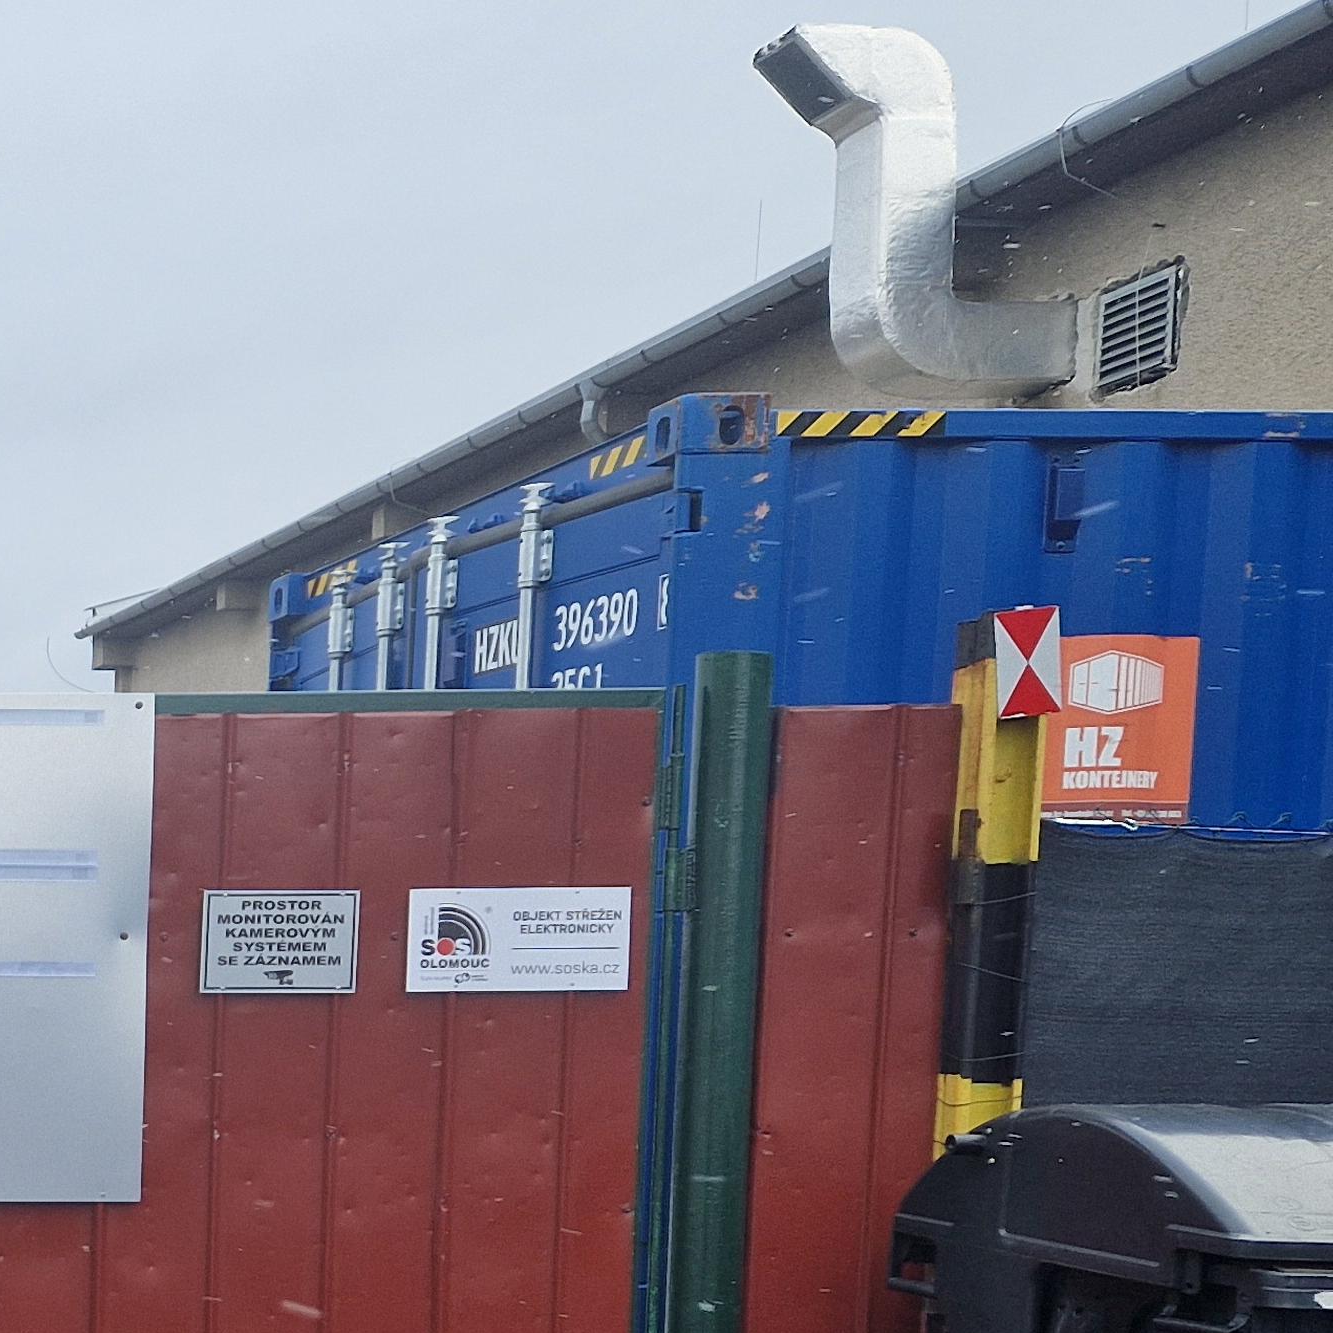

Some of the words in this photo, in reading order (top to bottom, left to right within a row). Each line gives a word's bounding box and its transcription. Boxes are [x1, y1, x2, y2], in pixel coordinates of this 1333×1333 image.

[474, 619, 519, 673] HZKU
[553, 588, 638, 651] 396390
[1064, 727, 1124, 768] HZ
[1062, 770, 1159, 789] KONTEJNERY
[241, 900, 322, 911] PROSTOR
[217, 912, 345, 924] MONITOROVÁN
[513, 911, 561, 921] OBJEKT
[566, 908, 622, 921] STŘEŽEN
[225, 926, 336, 938] KAMEROVÝM
[520, 924, 614, 934] ELEKTRONICKY
[233, 940, 326, 952] SYSTÉMEM
[217, 956, 238, 966] SE
[243, 953, 341, 966] ZÁZNAMEM
[420, 959, 490, 968] OLOMOUC
[511, 961, 620, 974] www.soska.cz
